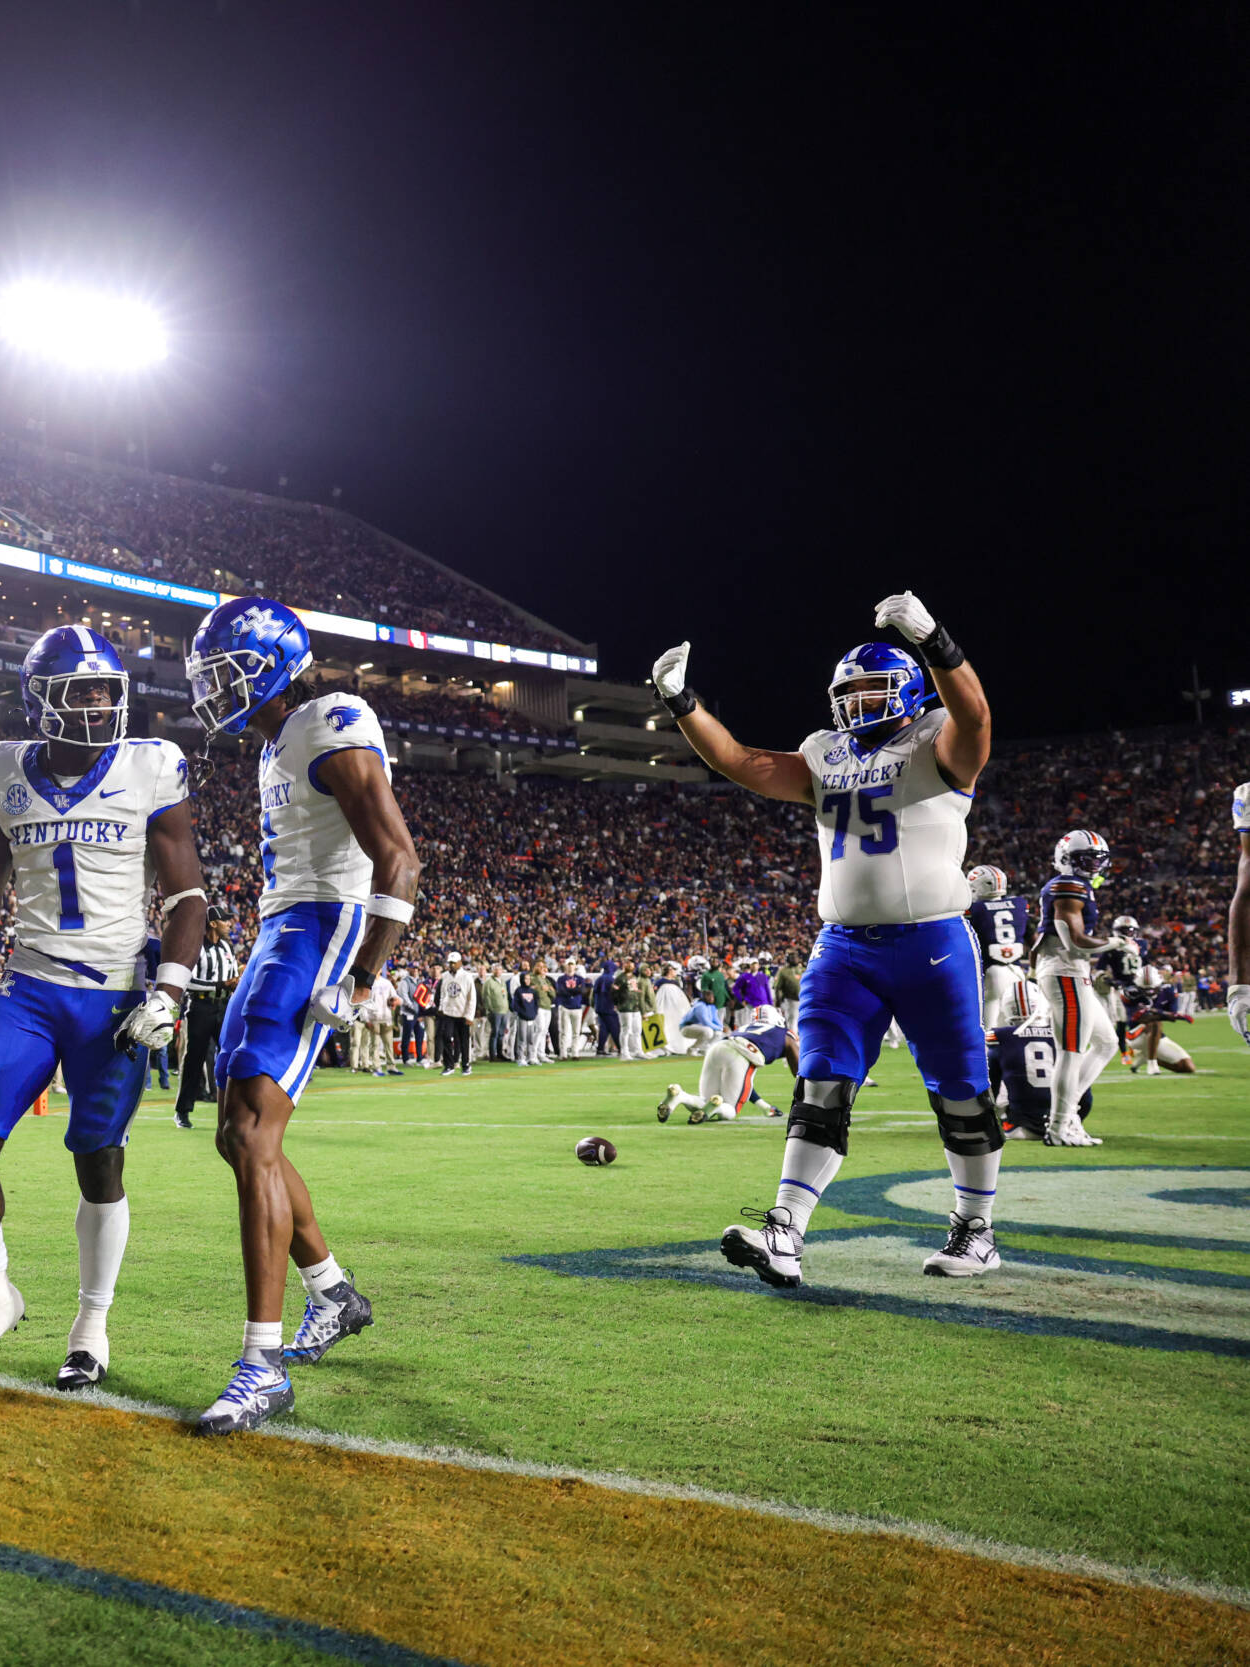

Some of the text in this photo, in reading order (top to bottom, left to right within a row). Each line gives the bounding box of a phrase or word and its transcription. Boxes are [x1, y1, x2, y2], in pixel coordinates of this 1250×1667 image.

[821, 759, 906, 790] KENTUCKY
[10, 821, 128, 845] KENTUCKY
[822, 784, 898, 861] 75
[52, 841, 85, 930] 1
[993, 910, 1016, 944] 6
[641, 1022, 665, 1049] 12
[1024, 1041, 1054, 1088] 8
